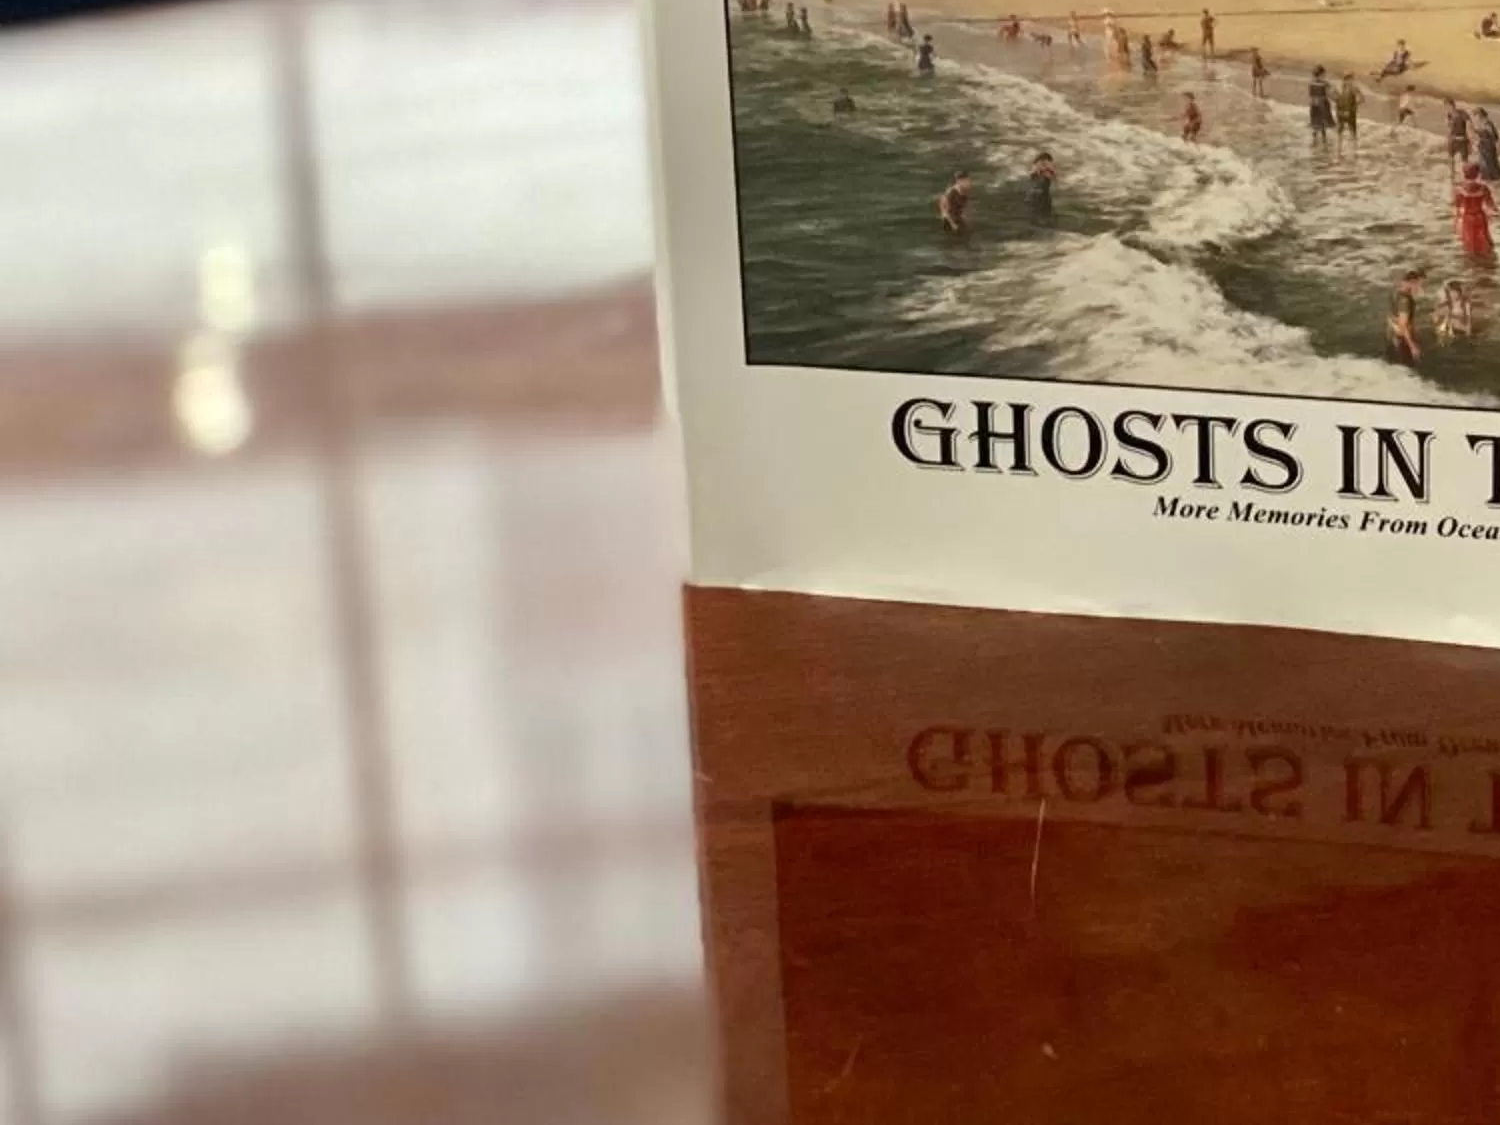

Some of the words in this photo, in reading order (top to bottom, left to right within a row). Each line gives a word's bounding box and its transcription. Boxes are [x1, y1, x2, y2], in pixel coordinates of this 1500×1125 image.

[891, 397, 1304, 494] GHOSTS
[1336, 425, 1437, 502] IN
[1153, 496, 1219, 520] More
[1228, 501, 1351, 530] Memories
[1359, 511, 1428, 535] From
